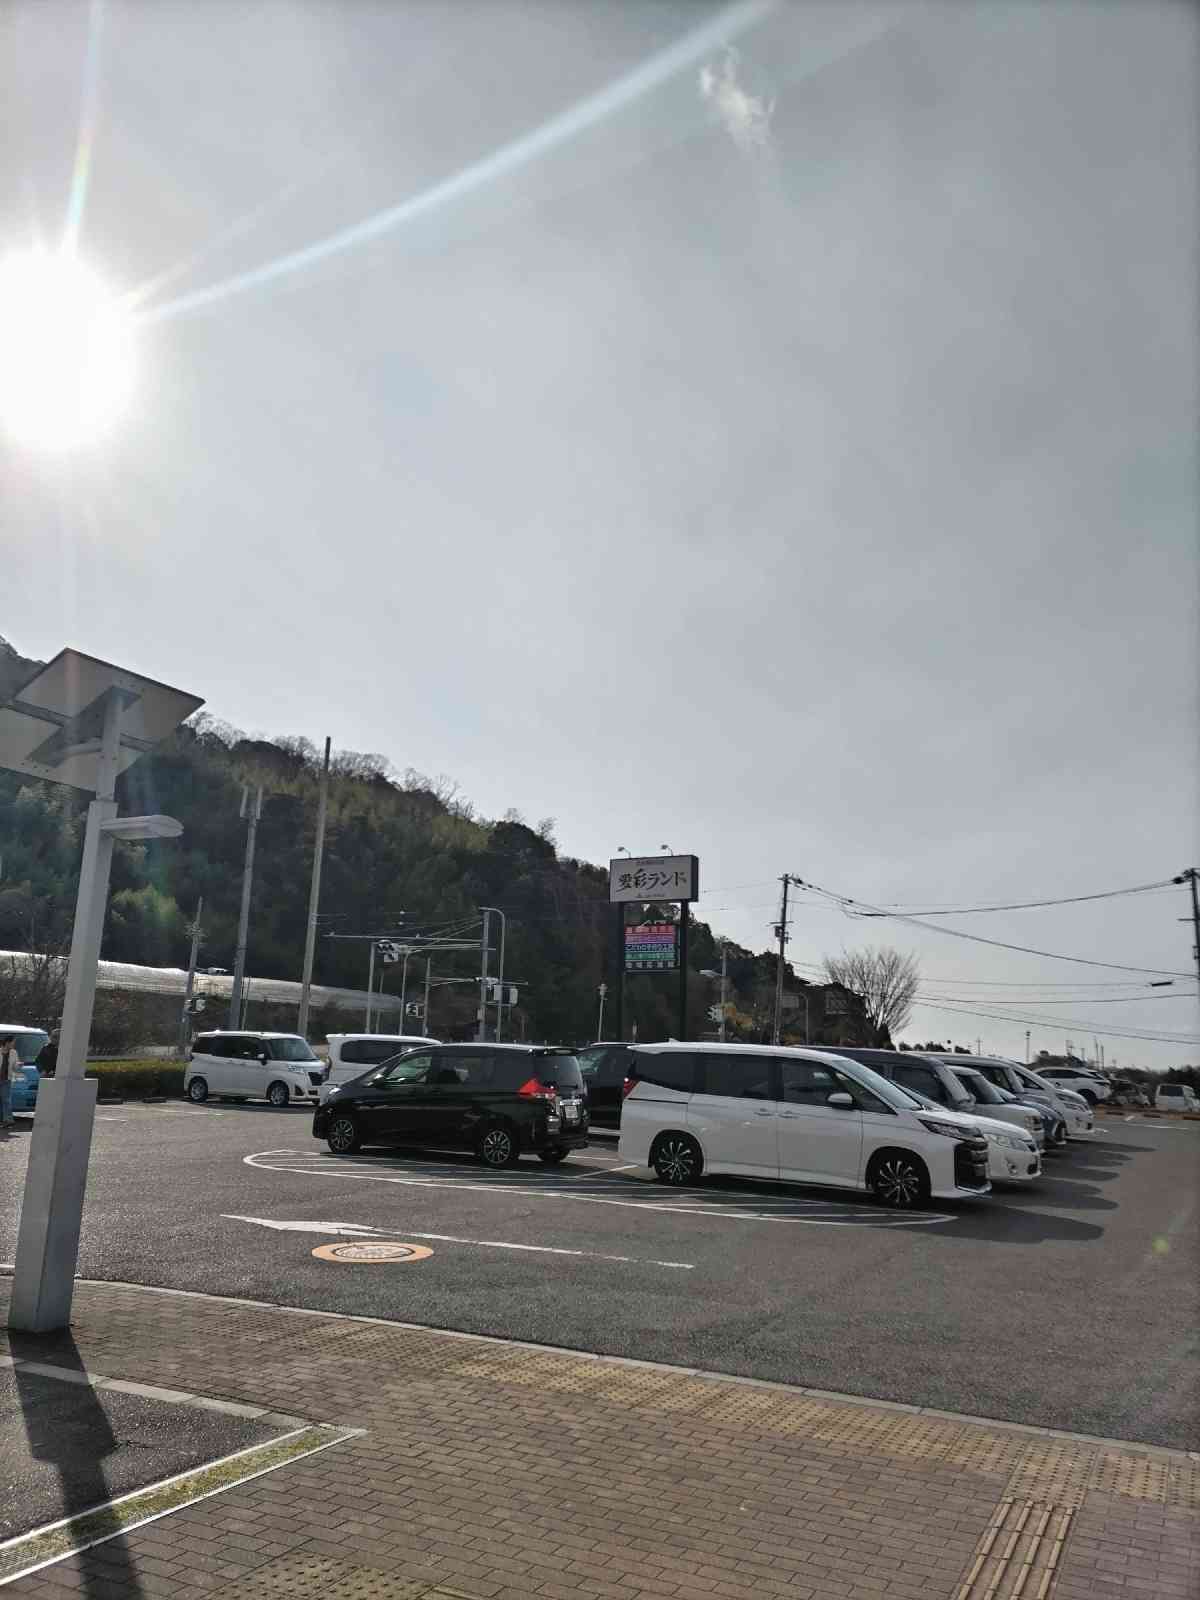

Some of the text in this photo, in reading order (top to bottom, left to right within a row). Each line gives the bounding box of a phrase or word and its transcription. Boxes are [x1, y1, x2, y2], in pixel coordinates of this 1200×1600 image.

[616, 868, 687, 892] 愛彩ランド
